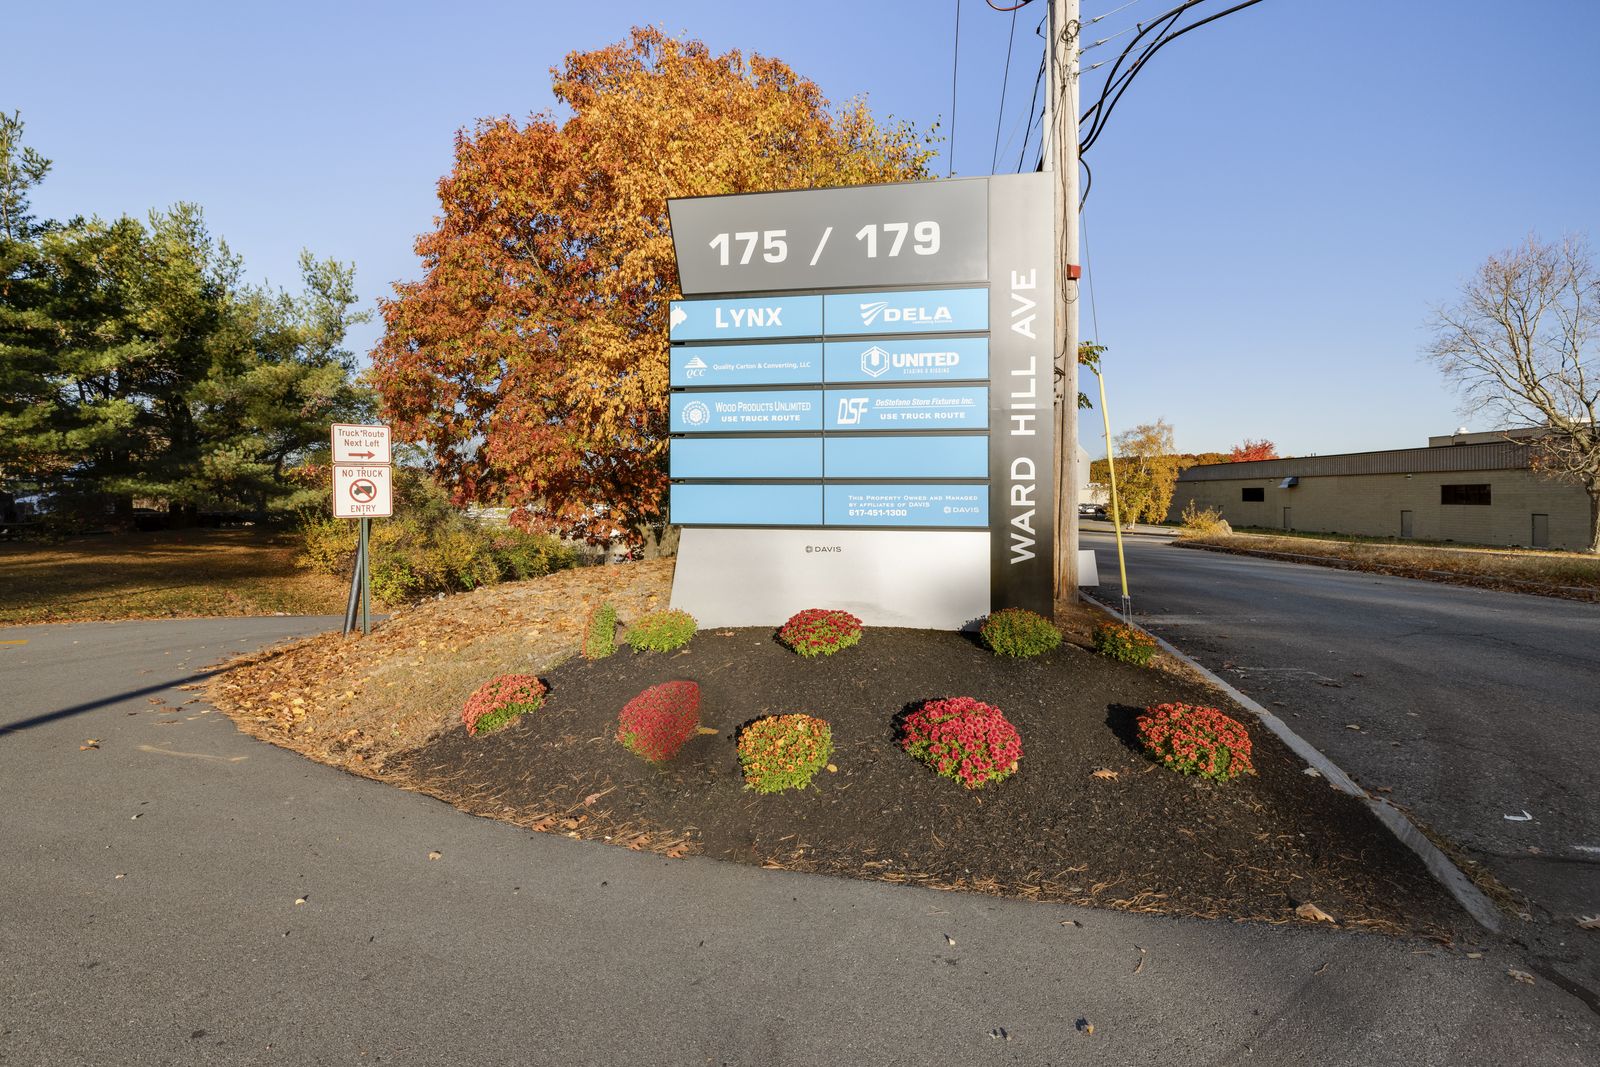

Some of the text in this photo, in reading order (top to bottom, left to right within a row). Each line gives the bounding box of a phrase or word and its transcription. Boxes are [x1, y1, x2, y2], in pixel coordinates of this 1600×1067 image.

[709, 221, 941, 266] 175 / 179
[715, 307, 783, 328] LYNX
[884, 306, 952, 322] DELA
[892, 352, 960, 368] UNITED
[712, 363, 735, 371] Quality
[686, 369, 706, 379] QCC
[911, 398, 930, 406] Store
[931, 398, 960, 406] Fixtures
[960, 397, 974, 405] Inc.
[837, 397, 870, 425] DSF
[1011, 268, 1036, 565] WARD HILL AVE
[338, 428, 385, 438] Truck Route
[342, 469, 384, 477] NO TRUCK
[350, 505, 377, 513] ENTRY
[848, 509, 907, 517] 617-451-1300
